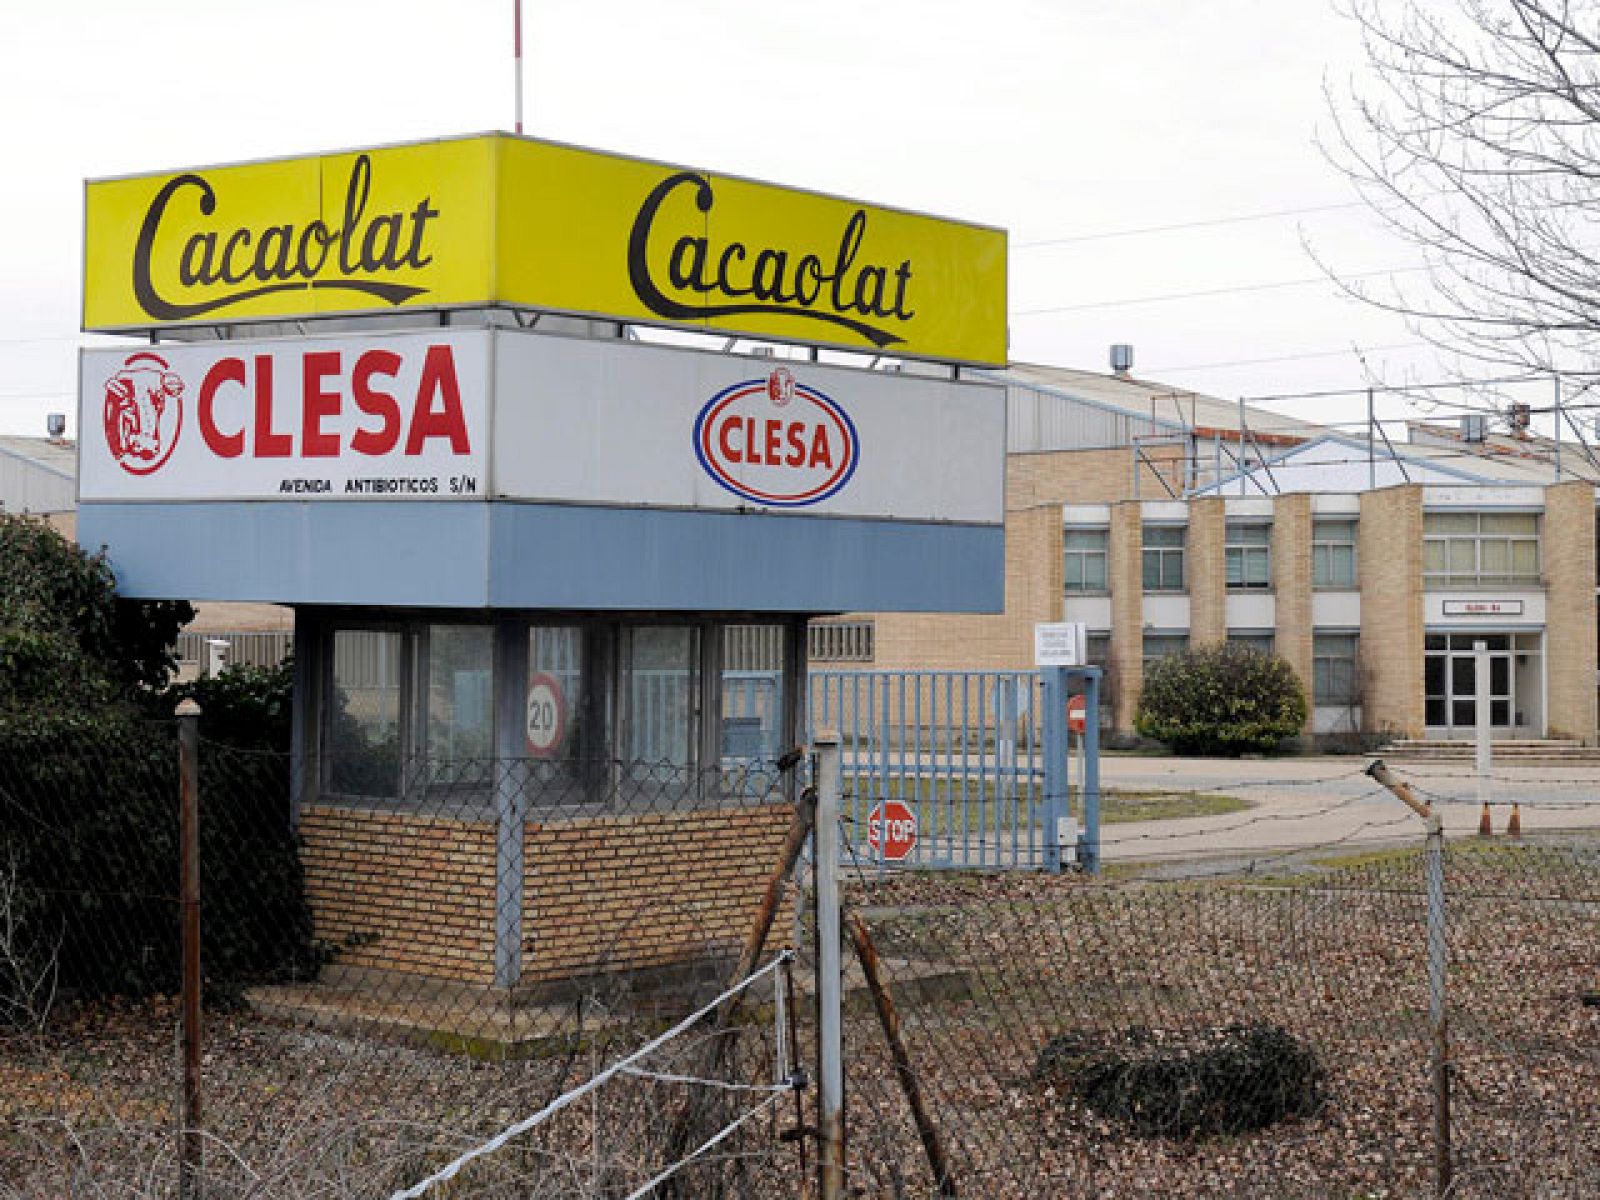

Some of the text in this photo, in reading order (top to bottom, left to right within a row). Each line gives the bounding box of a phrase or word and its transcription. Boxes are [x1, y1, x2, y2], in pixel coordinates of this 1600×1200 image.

[133, 155, 438, 320] Cacaolat
[627, 172, 915, 347] Cacaolat
[198, 344, 470, 458] CLESA
[719, 415, 833, 470] CLESA
[279, 475, 476, 493] AVENIDA ANTIBIOTICOS S/N
[529, 701, 553, 731] 20
